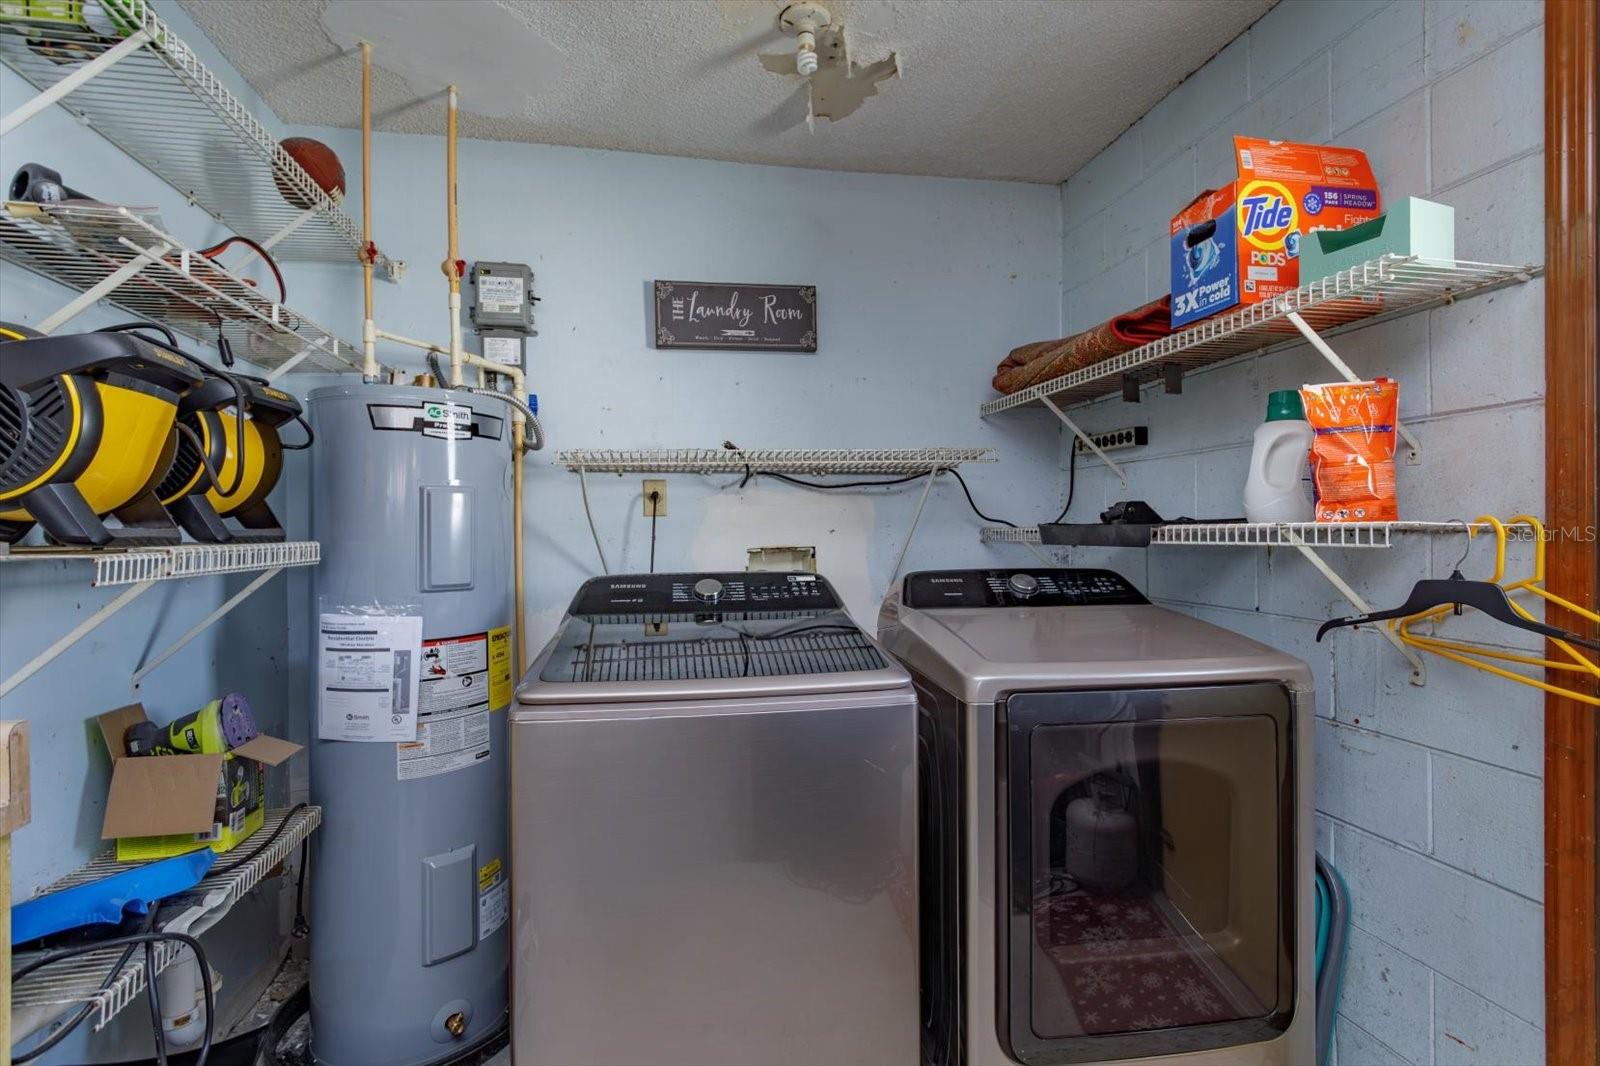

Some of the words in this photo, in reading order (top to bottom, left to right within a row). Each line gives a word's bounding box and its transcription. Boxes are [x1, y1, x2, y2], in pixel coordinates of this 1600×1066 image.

[1324, 191, 1338, 200] 156
[1343, 193, 1367, 201] SPRING
[1242, 196, 1292, 237] Tide
[1251, 250, 1286, 266] PODS
[1199, 276, 1229, 297] Power
[1209, 285, 1230, 303] cold
[672, 296, 684, 321] THE
[687, 290, 753, 328] Laundry
[758, 294, 804, 325] Room
[1173, 288, 1199, 317] 3X
